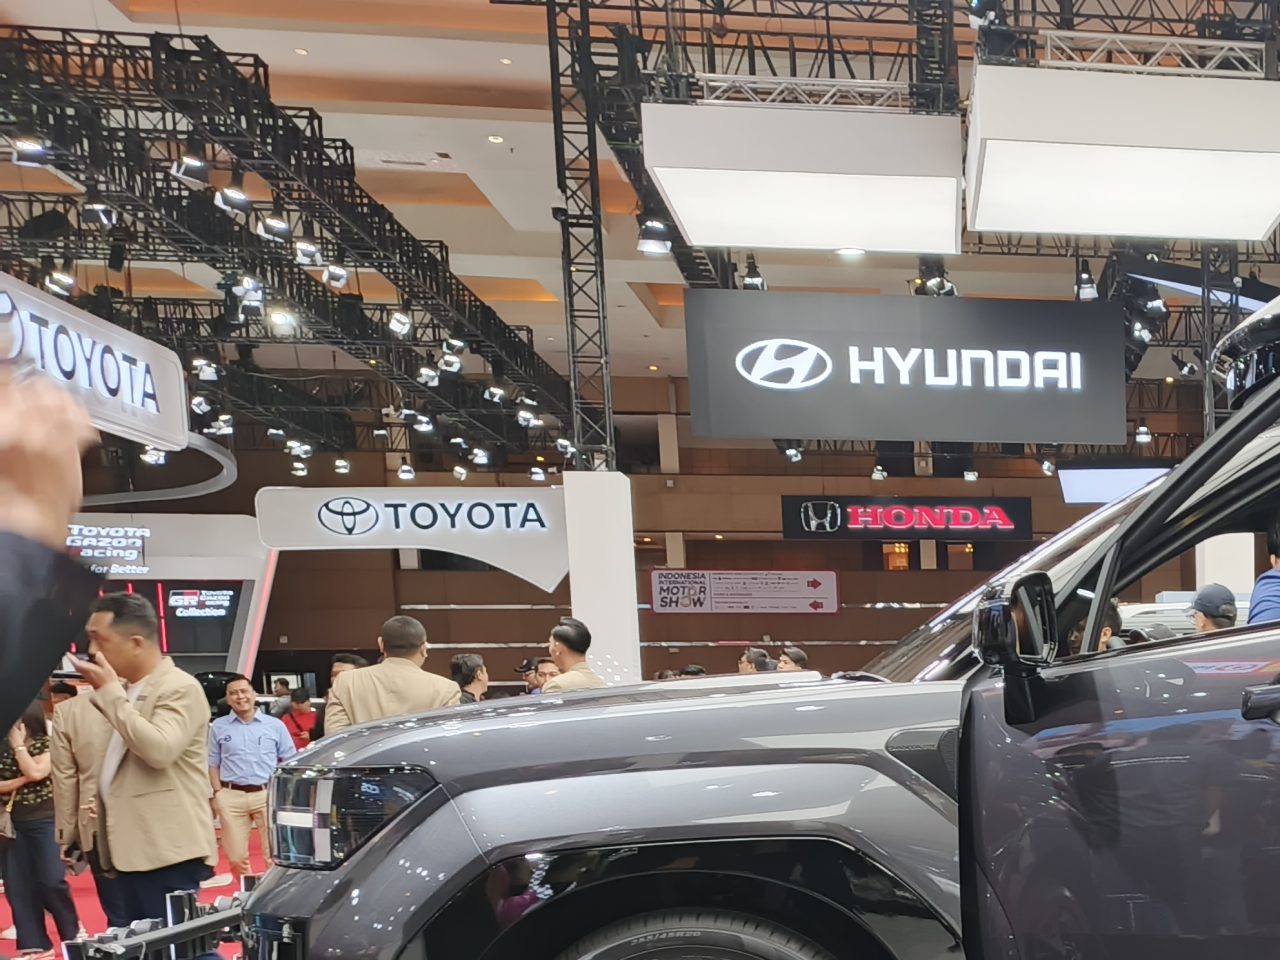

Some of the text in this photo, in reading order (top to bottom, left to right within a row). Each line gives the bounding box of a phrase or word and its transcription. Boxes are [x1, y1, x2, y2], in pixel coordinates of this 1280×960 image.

[26, 311, 161, 414] TOYOTA
[848, 345, 1082, 390] HYUNDAI
[383, 501, 547, 530] TOYOTA
[846, 505, 1016, 529] HONDA
[67, 524, 151, 537] TOYOTA
[110, 563, 150, 575] Better
[657, 572, 707, 580] INDONESIA
[169, 595, 198, 606] GR
[175, 607, 226, 617] Collection
